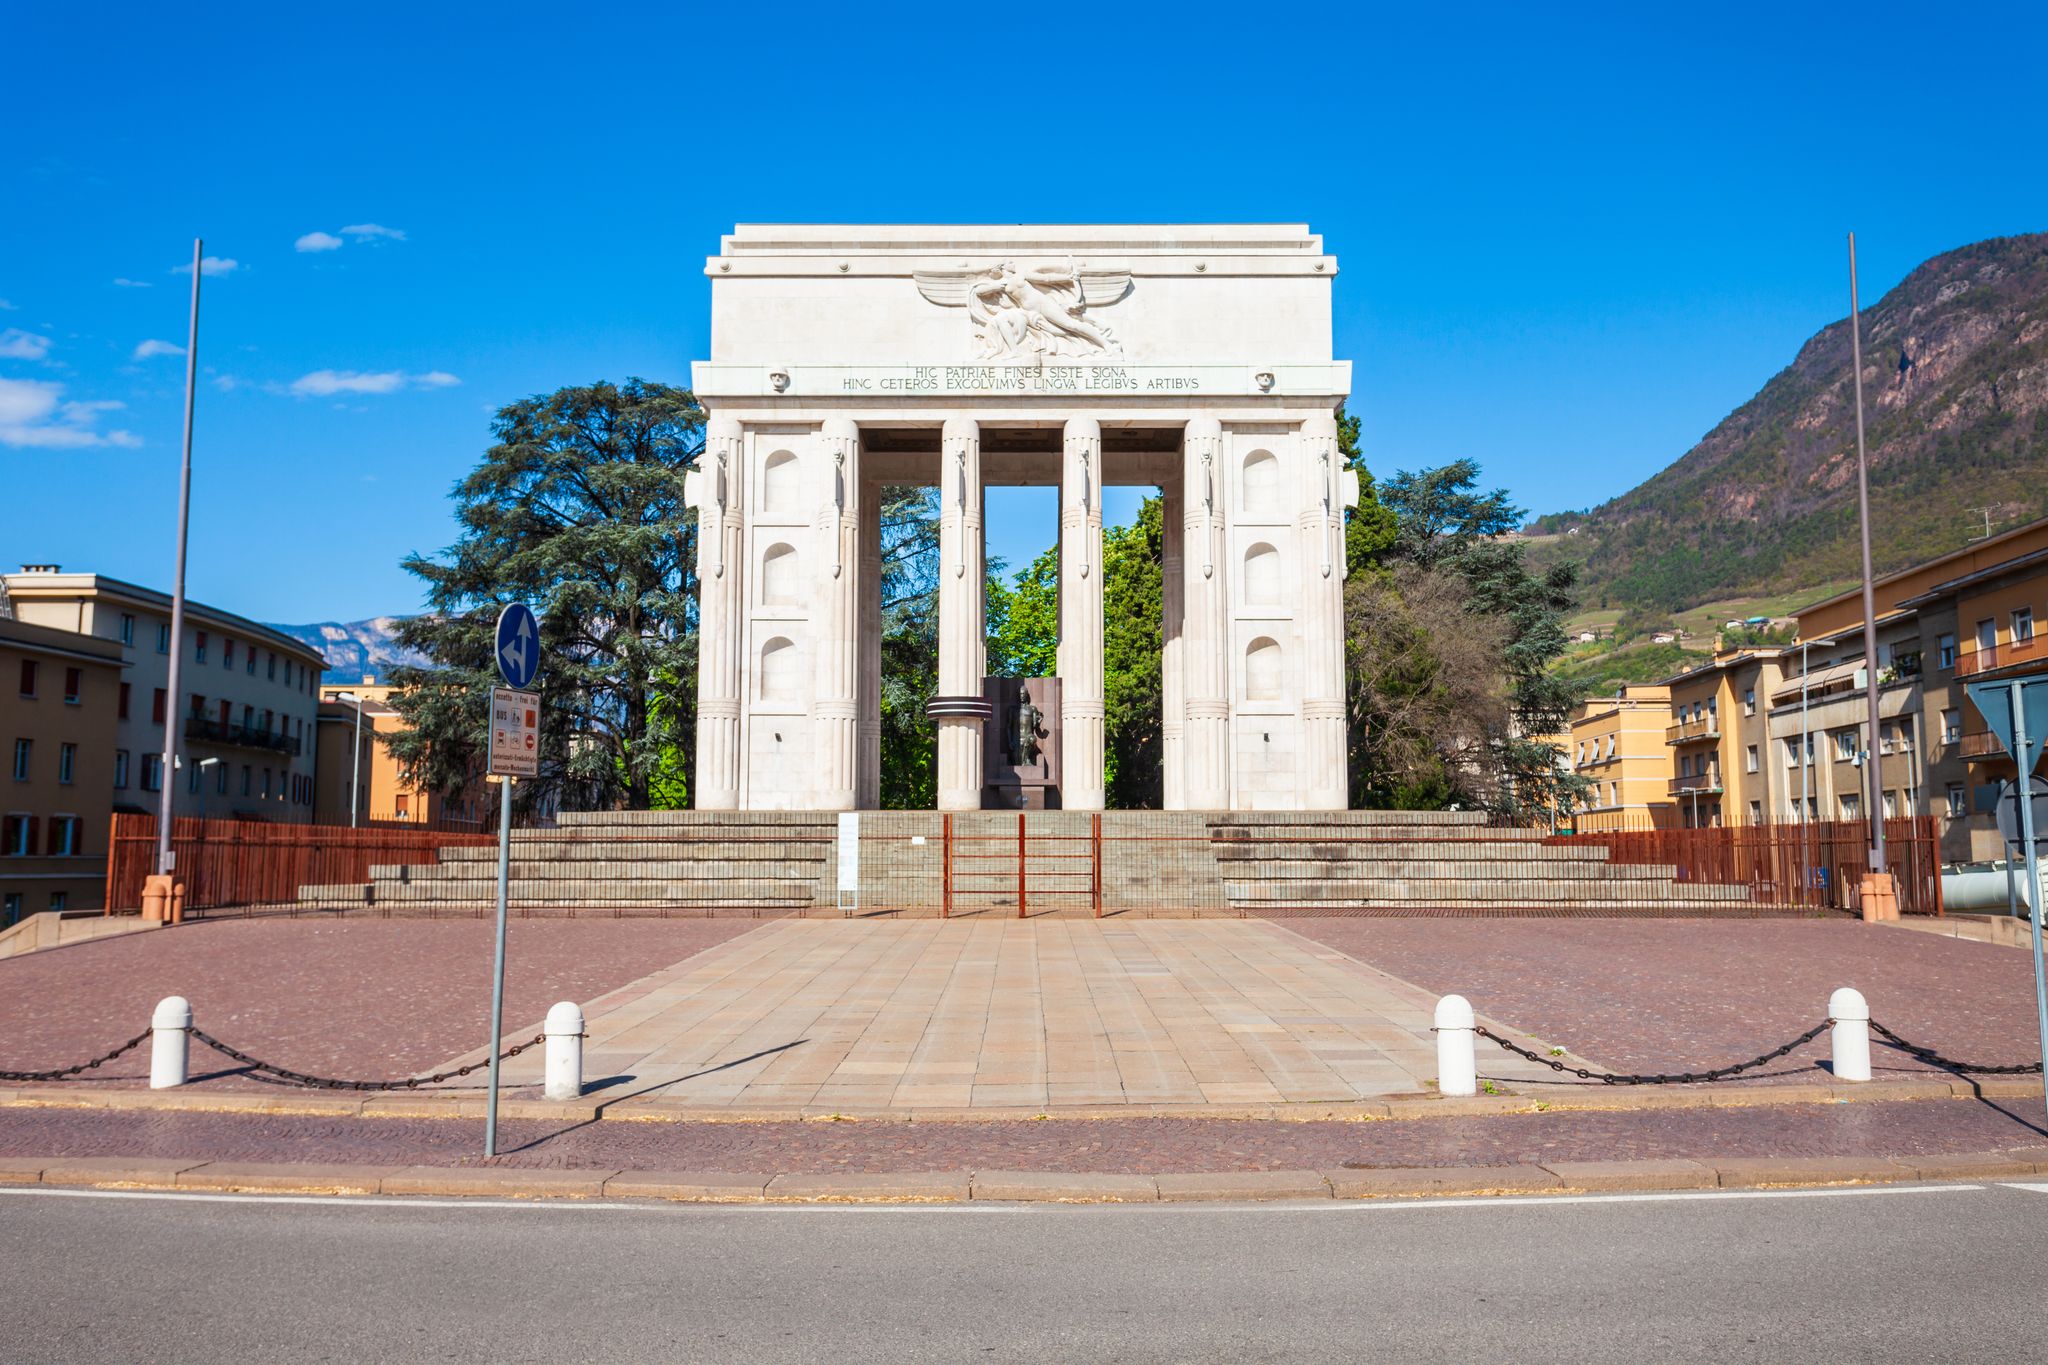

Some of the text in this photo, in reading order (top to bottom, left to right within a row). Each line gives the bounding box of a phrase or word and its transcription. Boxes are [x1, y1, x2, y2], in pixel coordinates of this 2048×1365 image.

[916, 367, 1127, 378] HIC PATRIAE FINES SISTE SIGNA
[843, 378, 1199, 389] HINC CETEROS EXCOLVIMVS LINGVA LEGIBVS ARTIBVS
[496, 710, 507, 720] BUS
